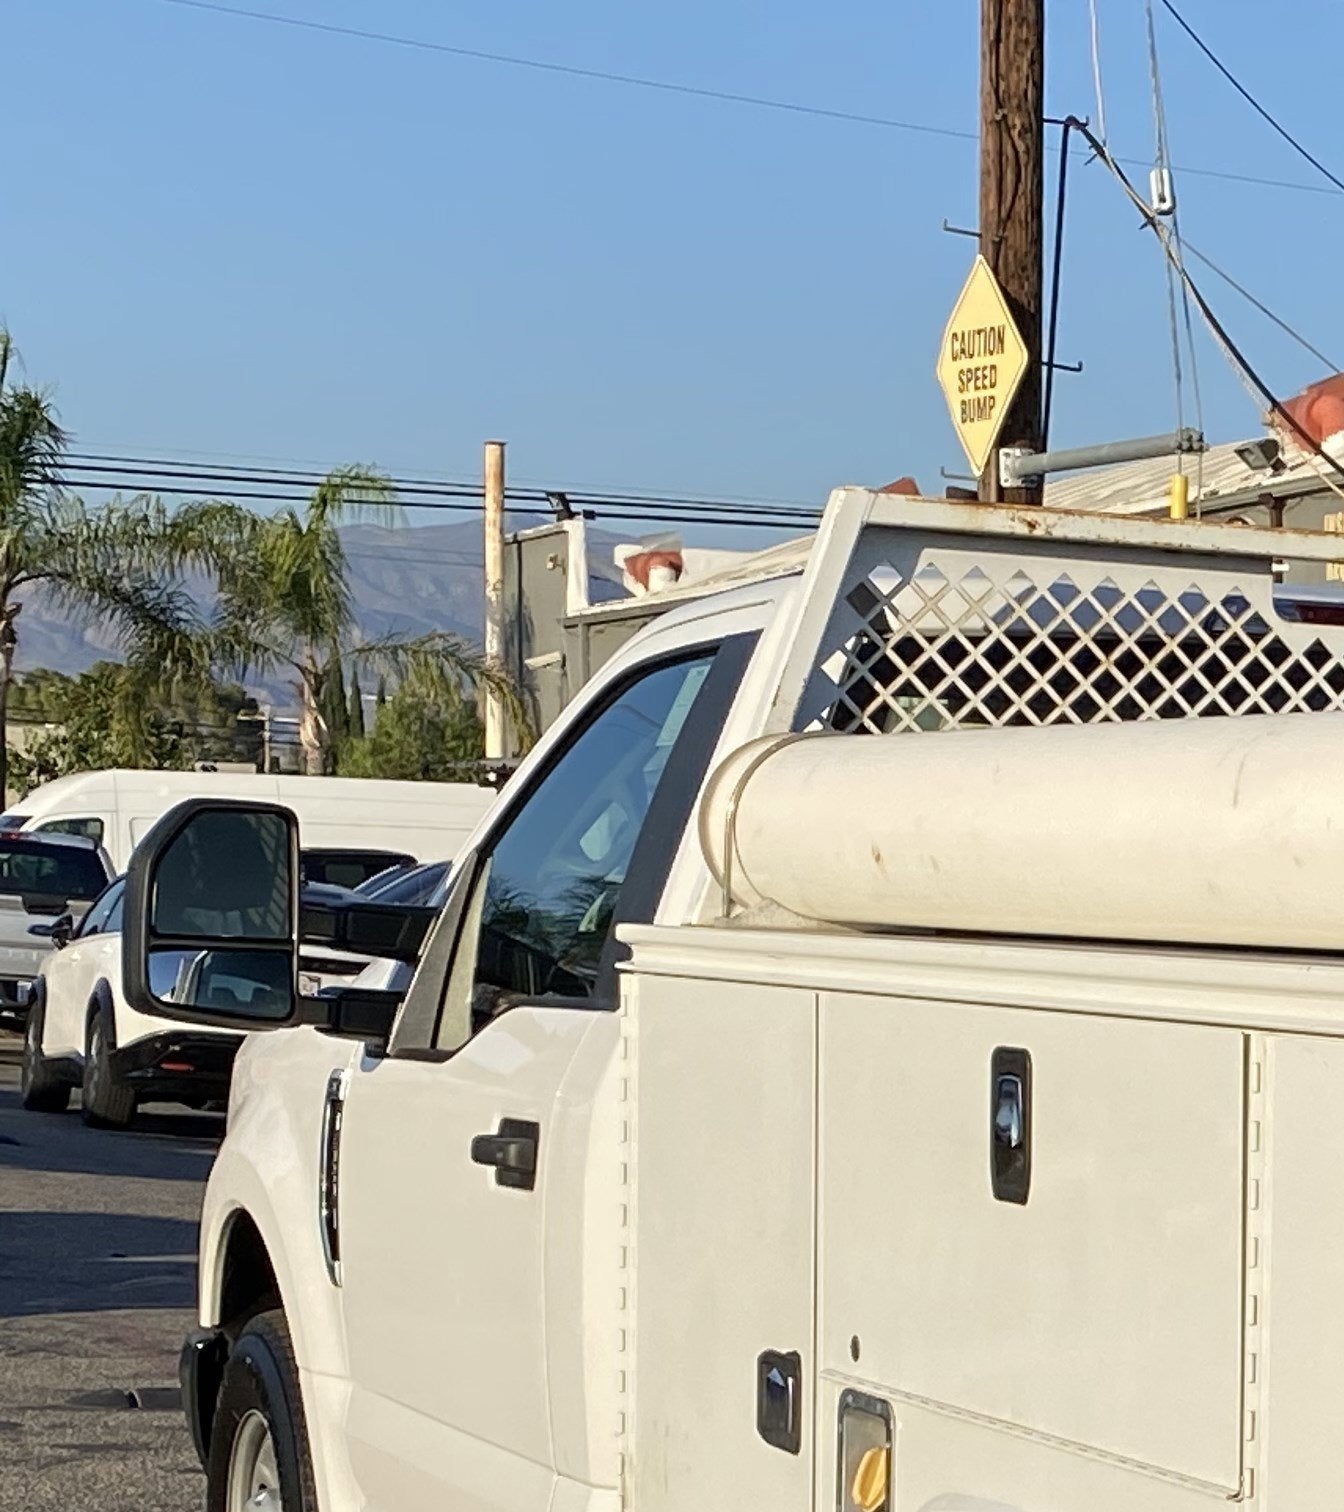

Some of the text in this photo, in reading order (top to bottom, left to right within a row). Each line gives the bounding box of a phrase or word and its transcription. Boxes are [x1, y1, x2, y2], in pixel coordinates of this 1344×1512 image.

[951, 325, 1005, 361] CAUTION
[958, 364, 997, 393] SPEED
[960, 395, 996, 424] BUMP
